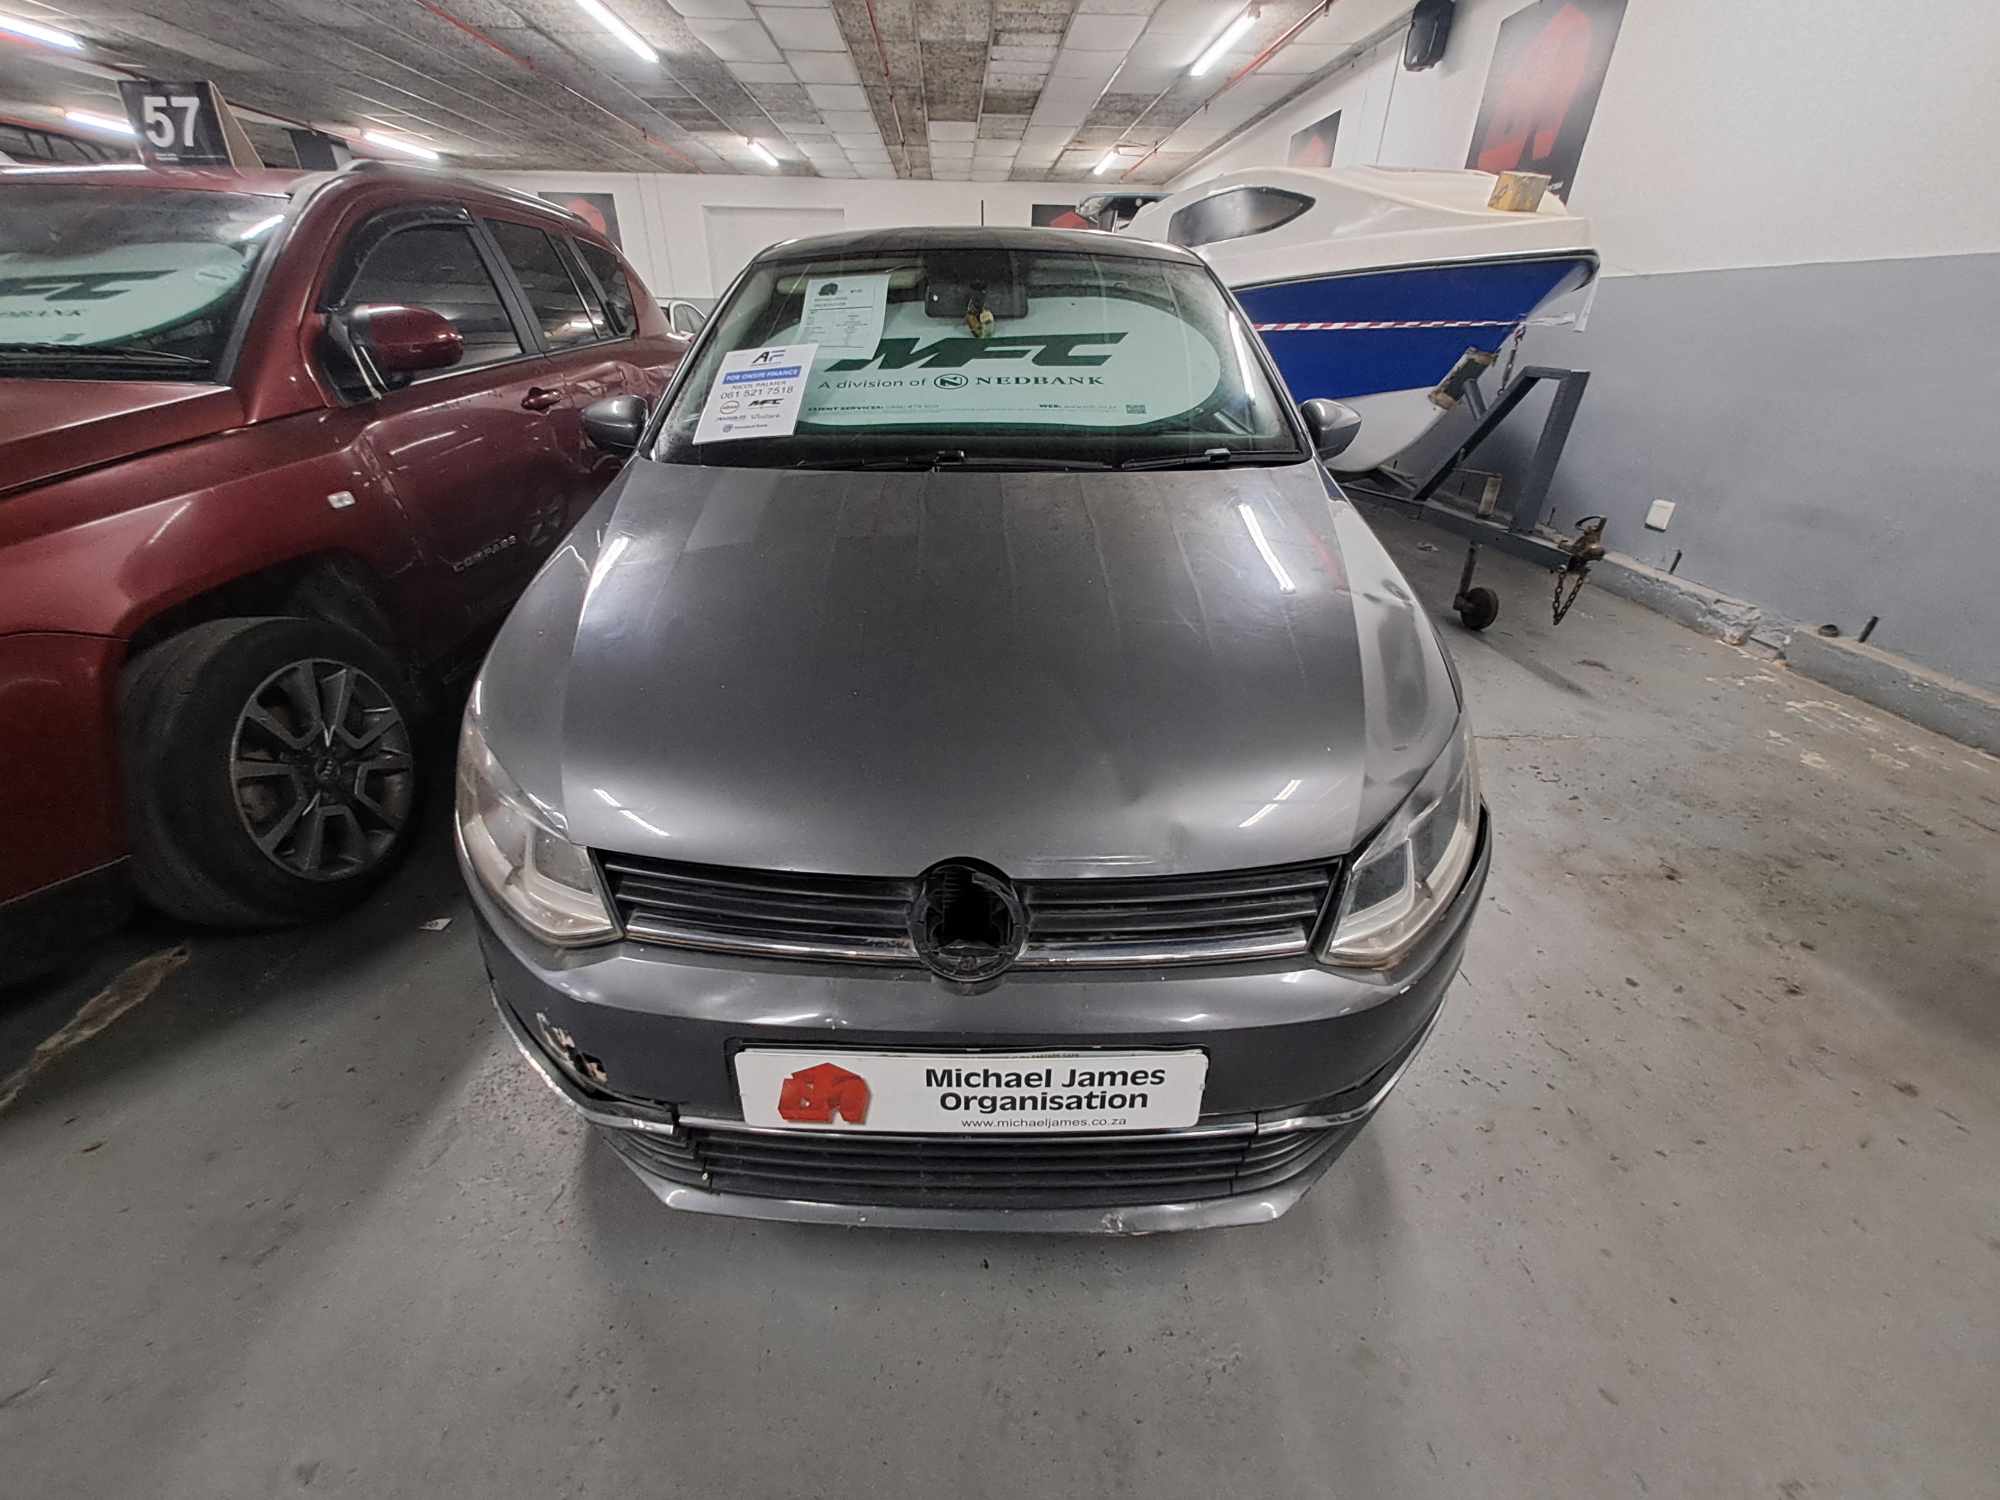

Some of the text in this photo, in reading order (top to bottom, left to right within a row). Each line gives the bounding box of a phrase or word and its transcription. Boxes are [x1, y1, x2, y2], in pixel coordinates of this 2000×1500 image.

[143, 96, 200, 148] 57
[824, 331, 1129, 373] MFC
[767, 368, 799, 378] FINANCE
[743, 389, 763, 397] 521
[767, 386, 794, 395] 7518
[817, 381, 831, 390] A
[836, 379, 904, 390] division
[909, 377, 927, 388] of
[976, 376, 1105, 386] NEDBANK
[925, 1068, 1166, 1089] Michael James
[939, 1090, 1149, 1114] Organisation
[961, 1116, 1127, 1128] www.michaeljames.co.za
